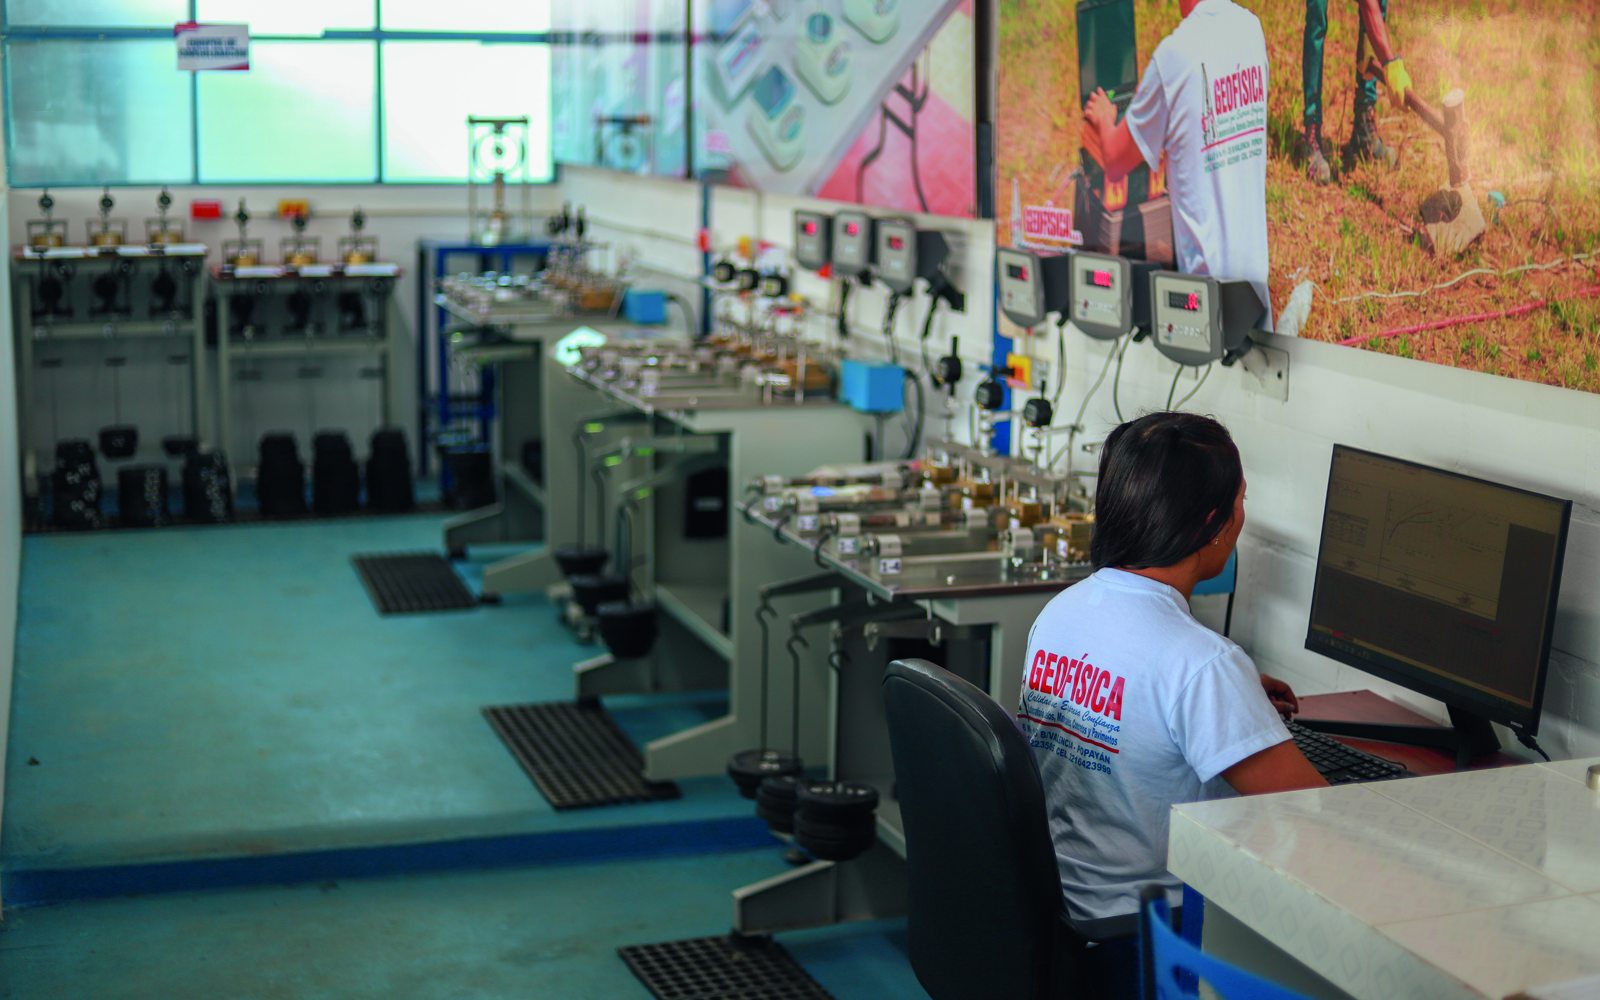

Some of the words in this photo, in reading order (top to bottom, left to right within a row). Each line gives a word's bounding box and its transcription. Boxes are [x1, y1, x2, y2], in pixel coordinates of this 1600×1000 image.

[1214, 63, 1264, 116] GEOFÍSICA
[881, 560, 900, 573] 1-4
[1029, 649, 1126, 721] GEOFÍSICA
[1082, 710, 1120, 733] Confianza
[1077, 745, 1111, 764] POPAYÁN
